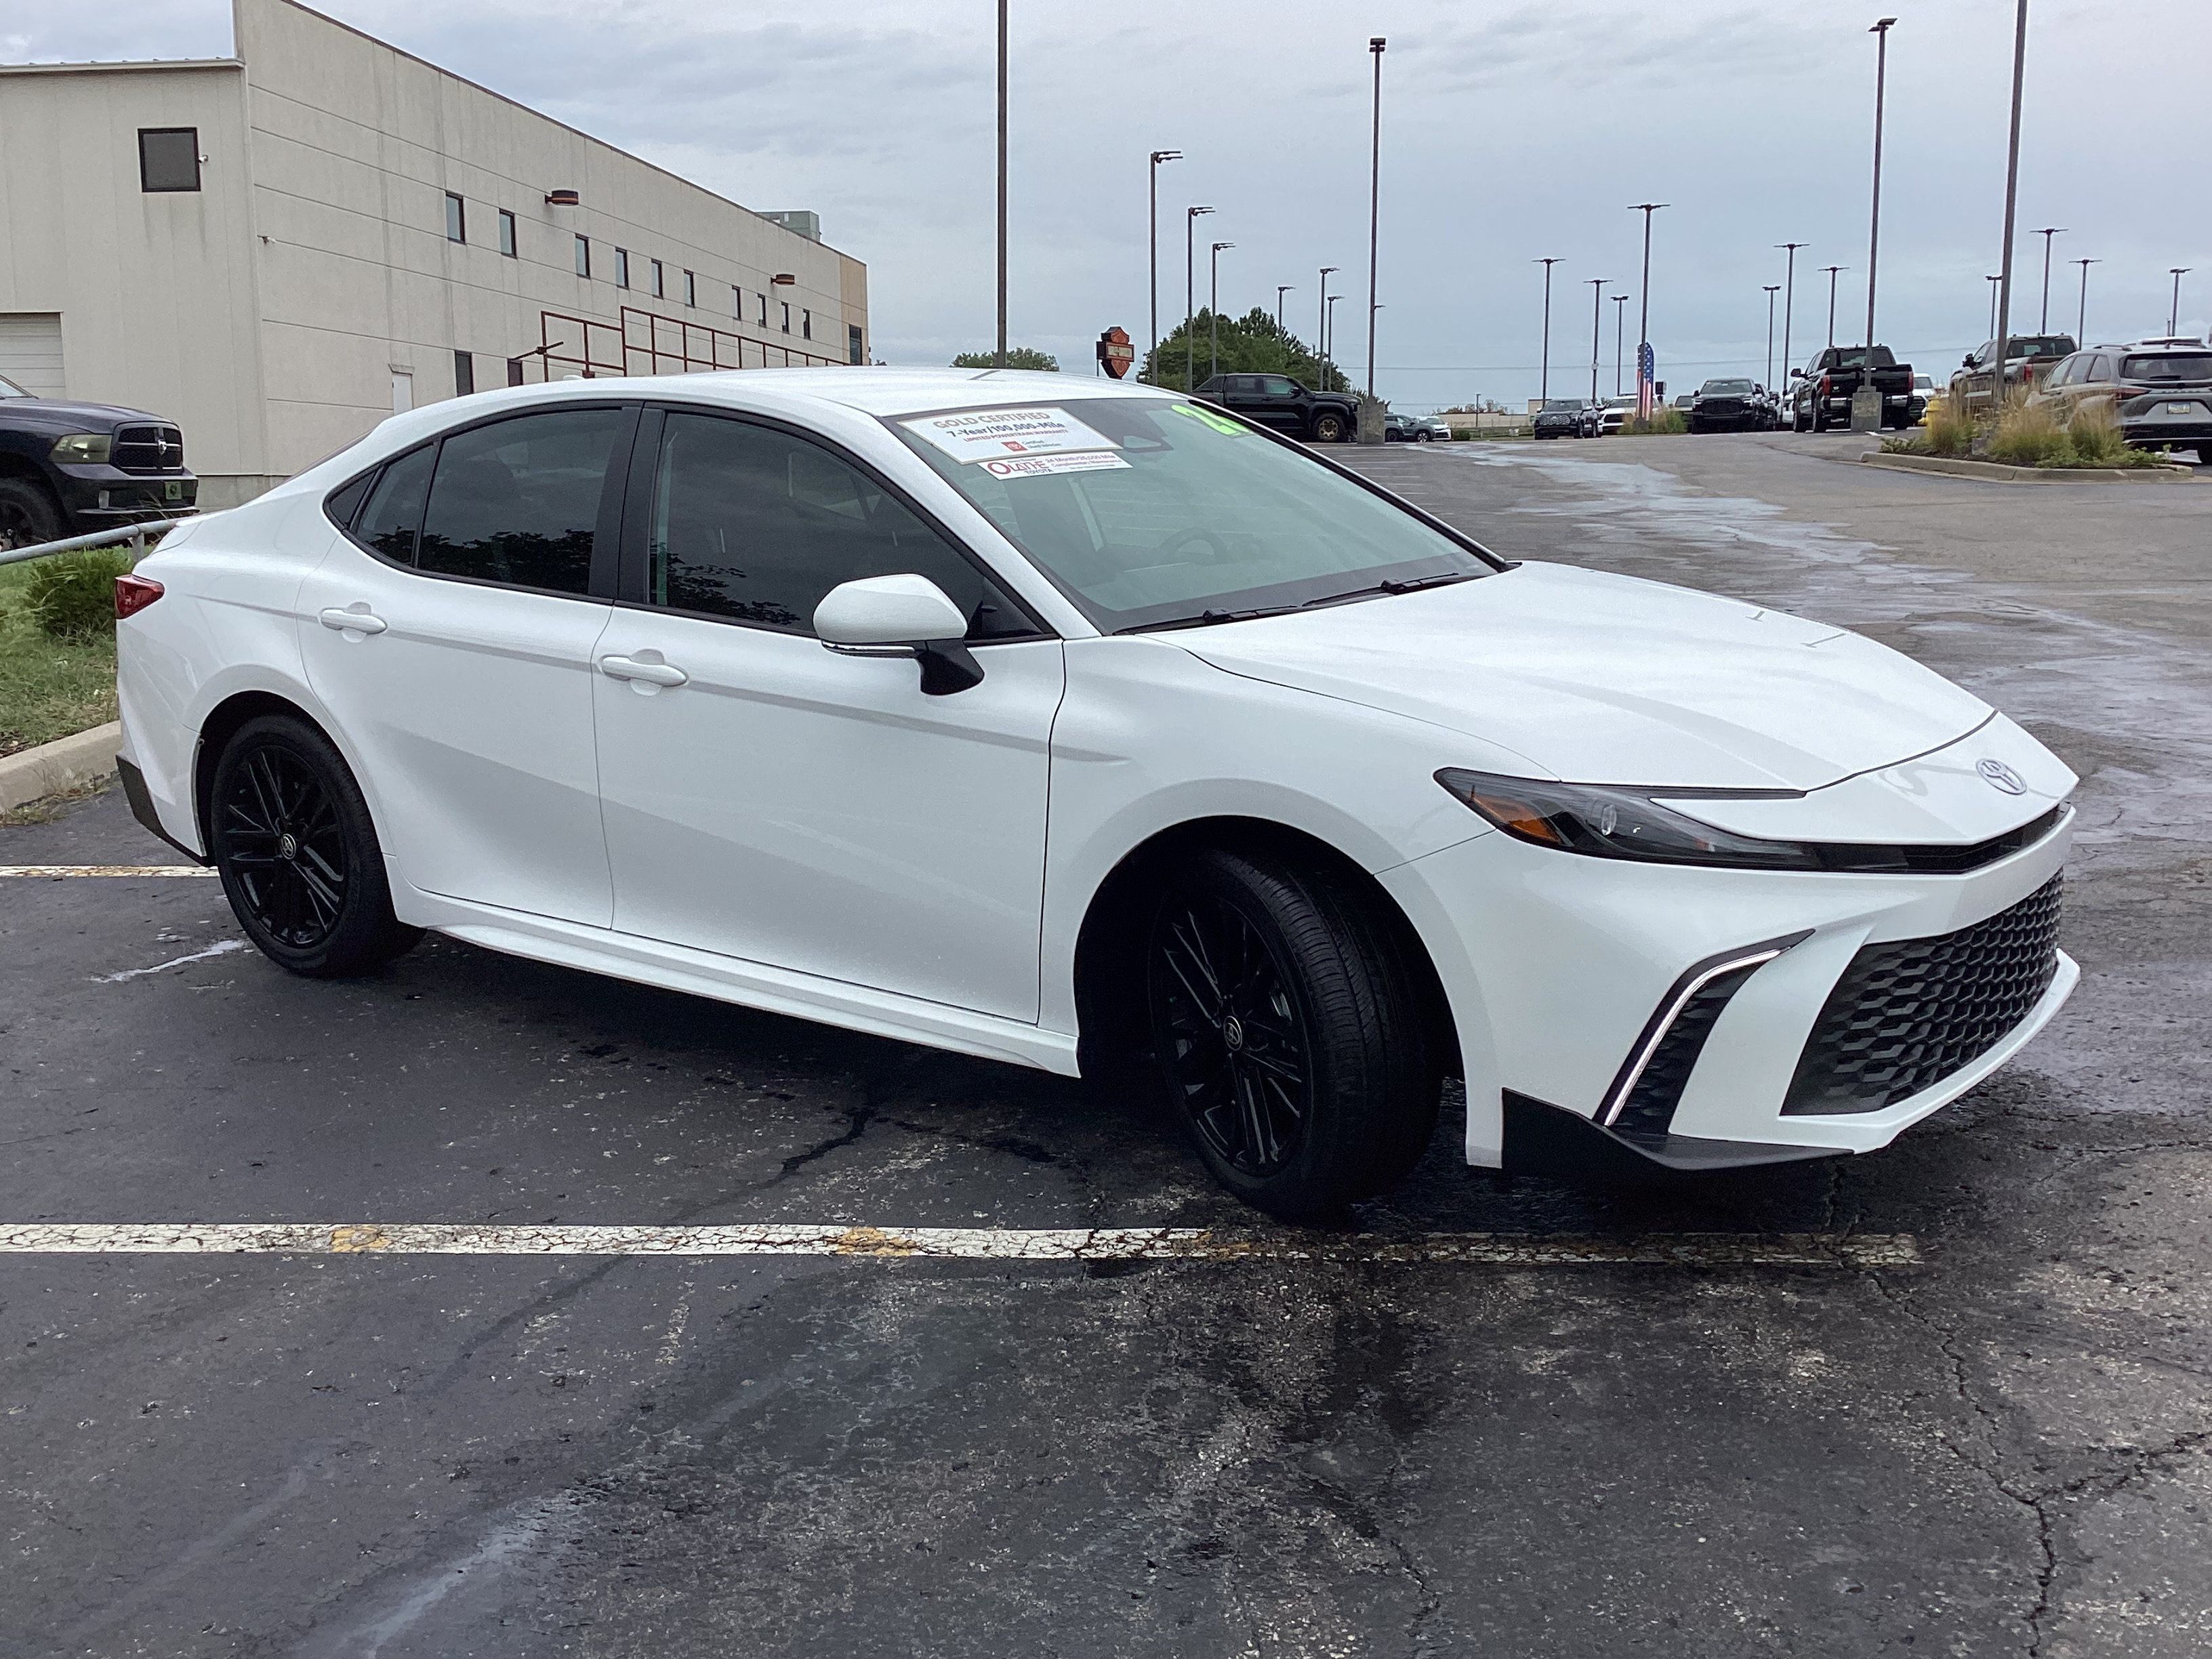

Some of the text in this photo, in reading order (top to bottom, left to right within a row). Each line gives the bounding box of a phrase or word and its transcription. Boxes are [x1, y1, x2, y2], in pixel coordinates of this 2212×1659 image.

[933, 412, 1050, 428] GOLD CERTIFIED
[946, 422, 1065, 437] 7-Year/100,000-Mile
[987, 461, 1050, 474] OLATHE
